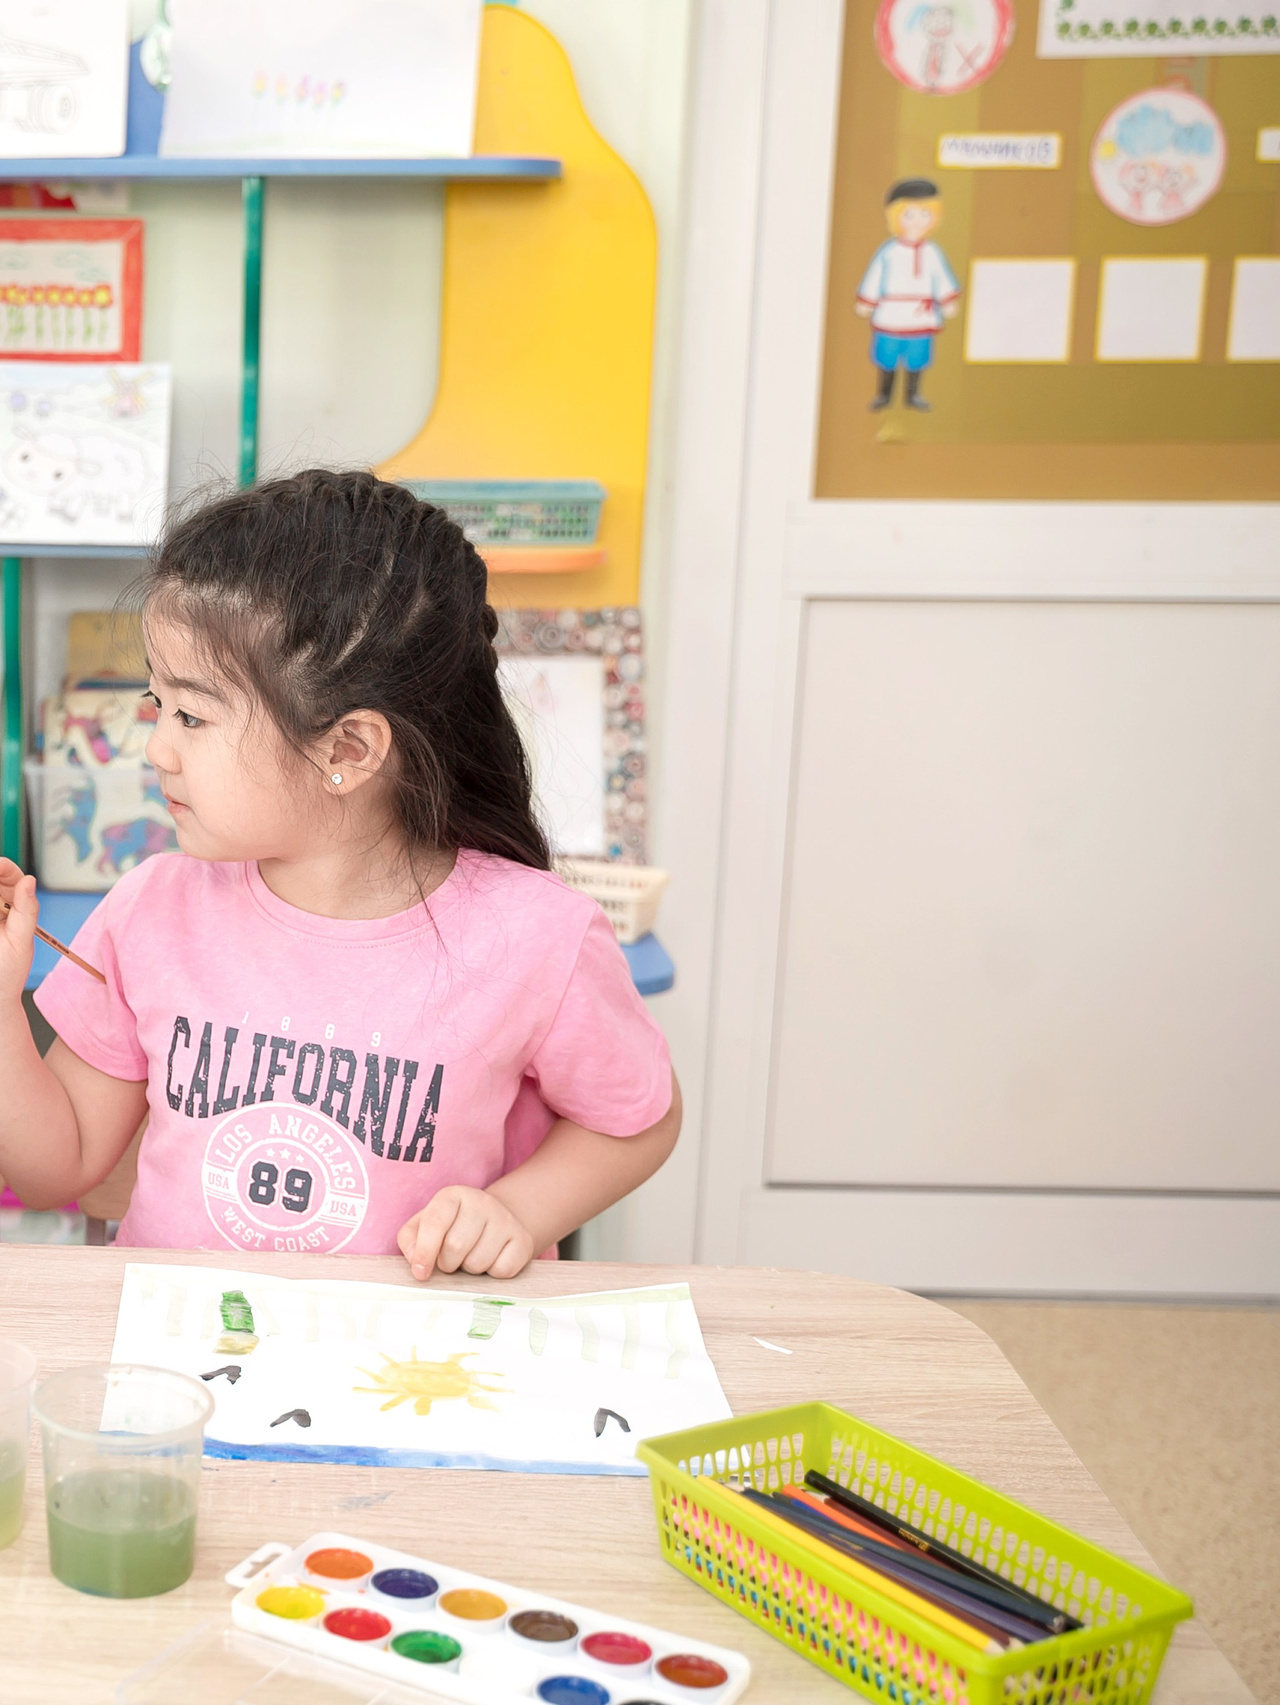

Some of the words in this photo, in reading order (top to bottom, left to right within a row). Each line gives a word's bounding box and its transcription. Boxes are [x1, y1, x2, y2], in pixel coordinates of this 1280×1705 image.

[166, 1015, 444, 1162] CALIFORNIA
[215, 1123, 253, 1164] LOS
[268, 1113, 356, 1190] ANGELES
[208, 1172, 230, 1190] USA
[248, 1161, 313, 1213] 89
[221, 1206, 266, 1248] WEST
[274, 1226, 330, 1252] COAST
[329, 1201, 357, 1217] USA
